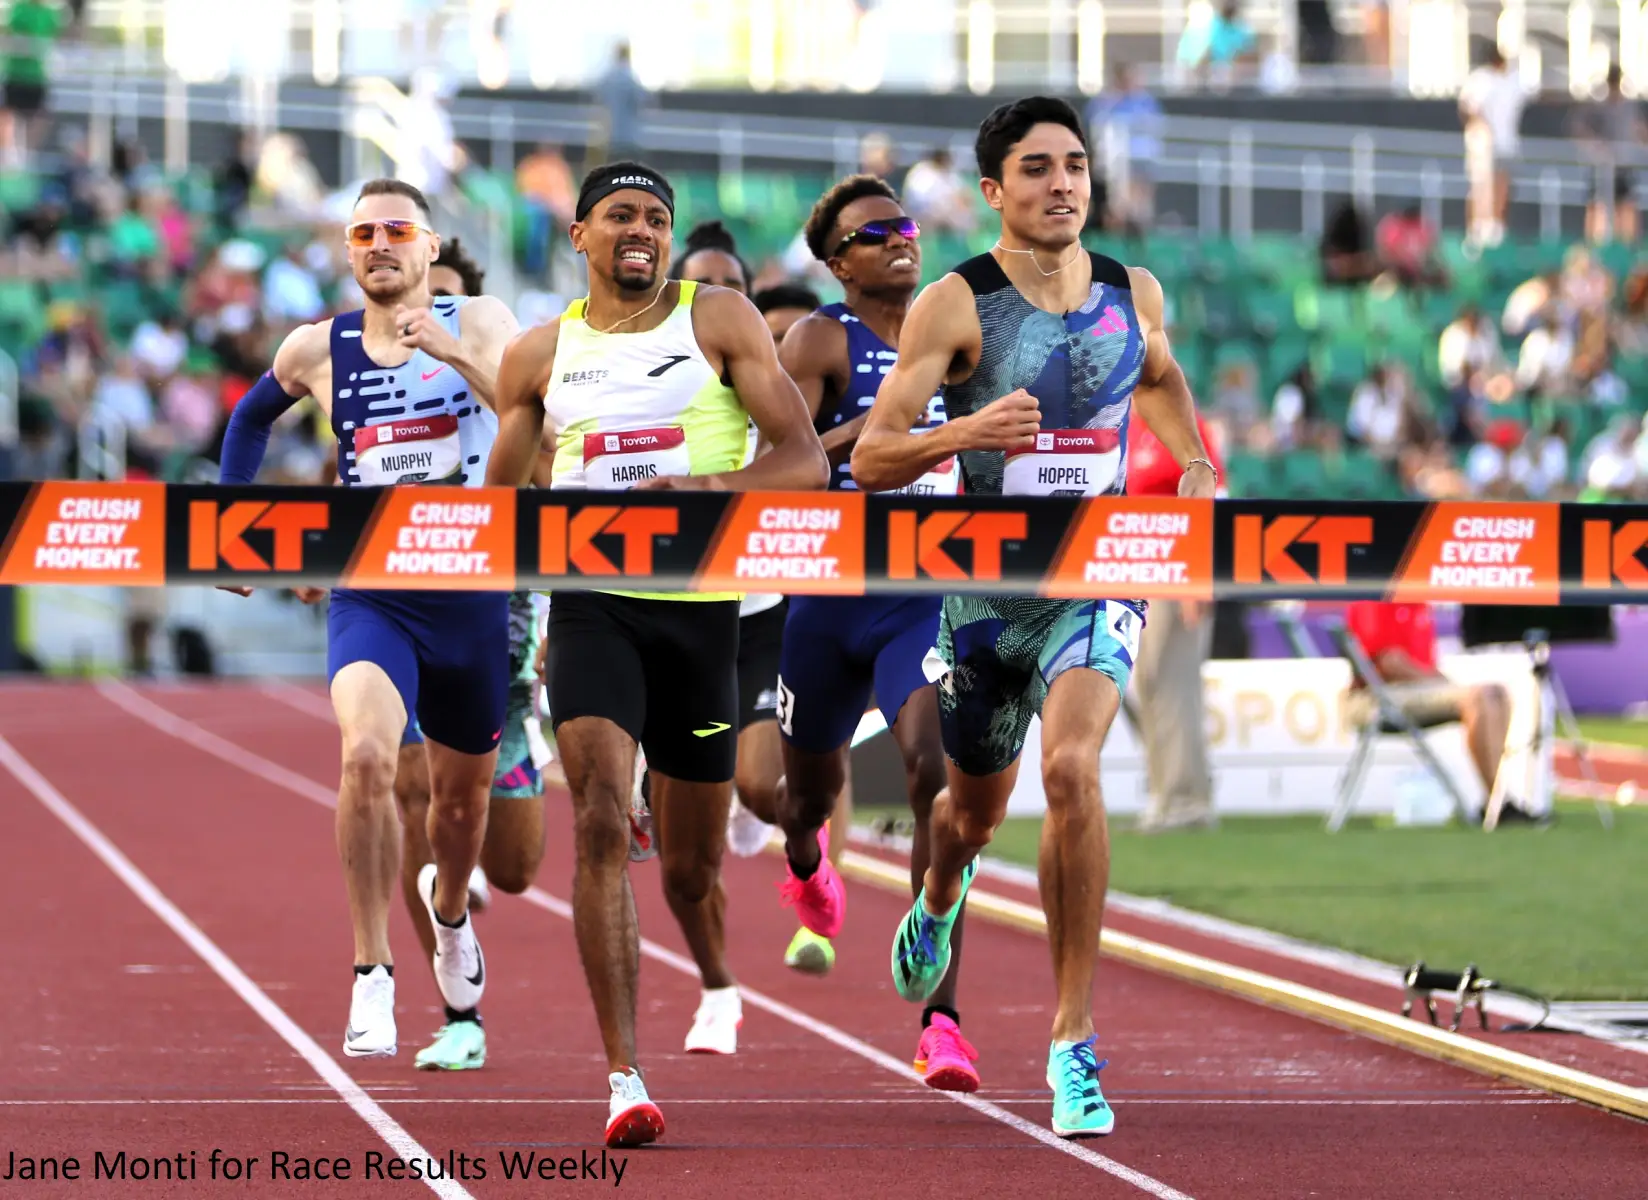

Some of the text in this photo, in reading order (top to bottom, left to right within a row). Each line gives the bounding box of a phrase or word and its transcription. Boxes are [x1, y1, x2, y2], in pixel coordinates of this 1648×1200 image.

[562, 370, 610, 383] BEASTS
[394, 425, 431, 436] TOYOTA
[621, 436, 658, 447] TOYOTA
[1056, 437, 1094, 447] TOYOTA
[381, 451, 432, 472] MURPHY
[611, 463, 658, 483] HARRIS
[1038, 467, 1089, 485] HOPPEL
[59, 498, 141, 521] CRUSH
[409, 502, 492, 525] CRUSH
[758, 508, 841, 531] CRUSH
[46, 521, 126, 545] EVERY
[189, 500, 329, 571] KT
[1107, 512, 1189, 536] CRUSH
[1453, 516, 1536, 540] CRUSH
[397, 527, 478, 550] EVERY
[540, 505, 679, 577] KT
[746, 531, 827, 555] EVERY
[887, 510, 1028, 582] KT
[1095, 537, 1176, 559] EVERY
[1233, 514, 1374, 585] KT
[34, 546, 141, 570] MOMENT.
[385, 551, 491, 575] MOMENT.
[1440, 540, 1522, 564] EVERY
[1582, 519, 1648, 590] K
[735, 556, 840, 580] MOMENT.
[1084, 561, 1188, 584] MOMENT.
[1428, 564, 1535, 589] MOMENT.
